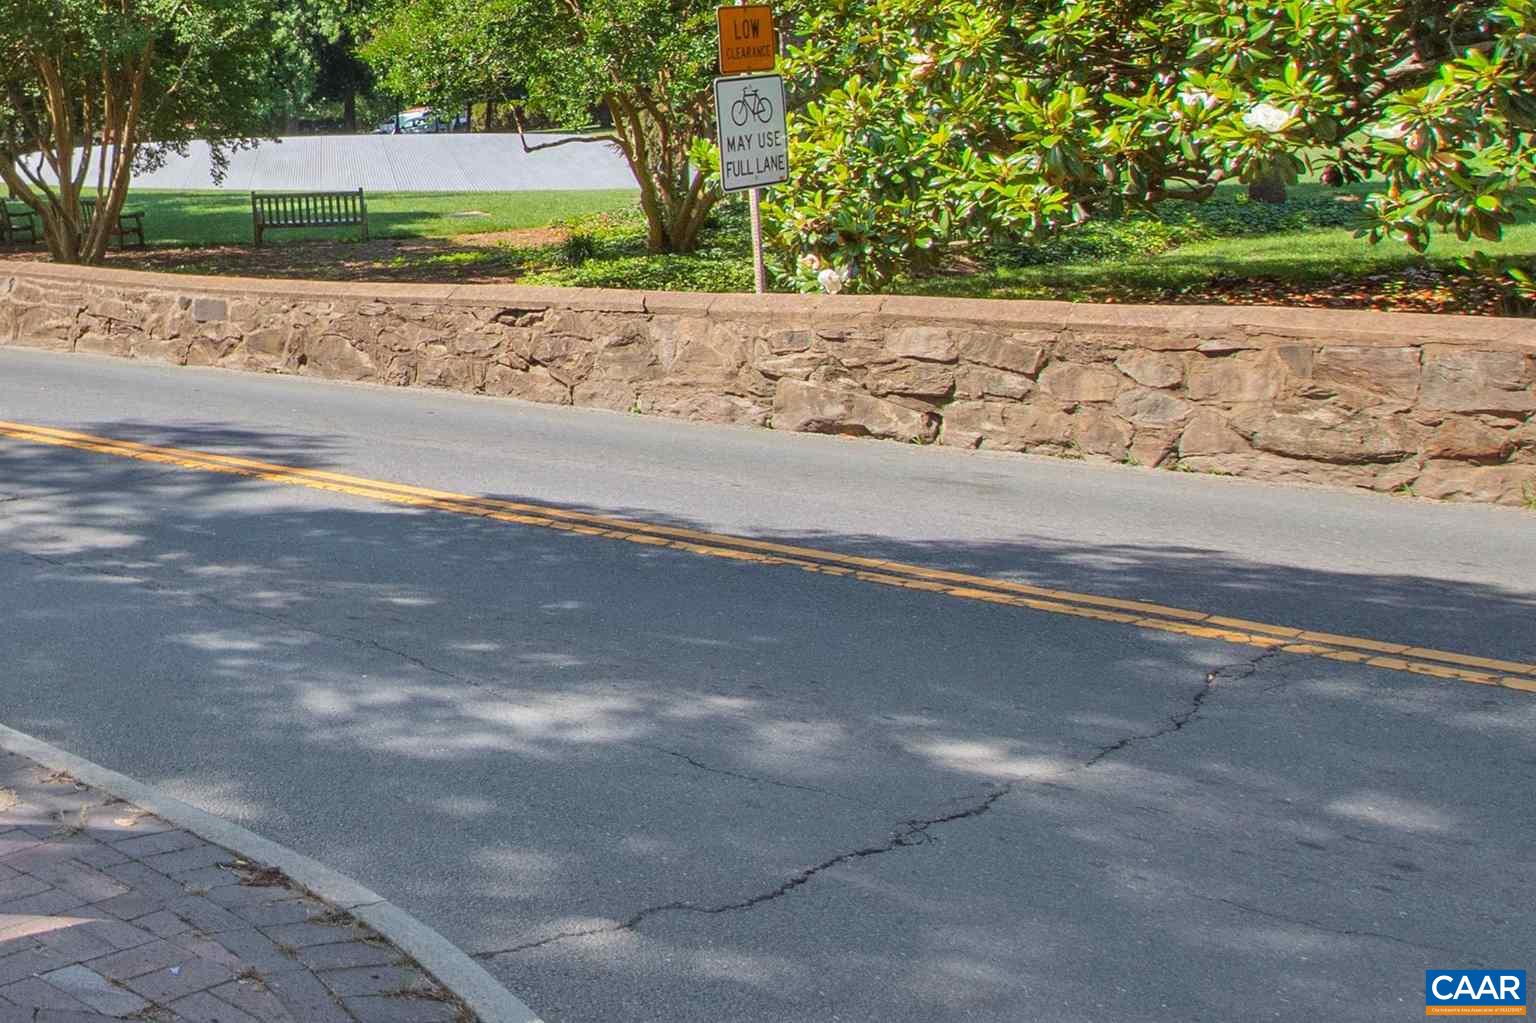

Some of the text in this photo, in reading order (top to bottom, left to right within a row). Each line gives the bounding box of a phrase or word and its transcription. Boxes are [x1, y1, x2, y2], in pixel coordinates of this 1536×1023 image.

[733, 18, 760, 40] LOW
[726, 44, 771, 60] CLEARANCE
[726, 130, 782, 153] MAY USE
[726, 154, 785, 178] FULL LANE
